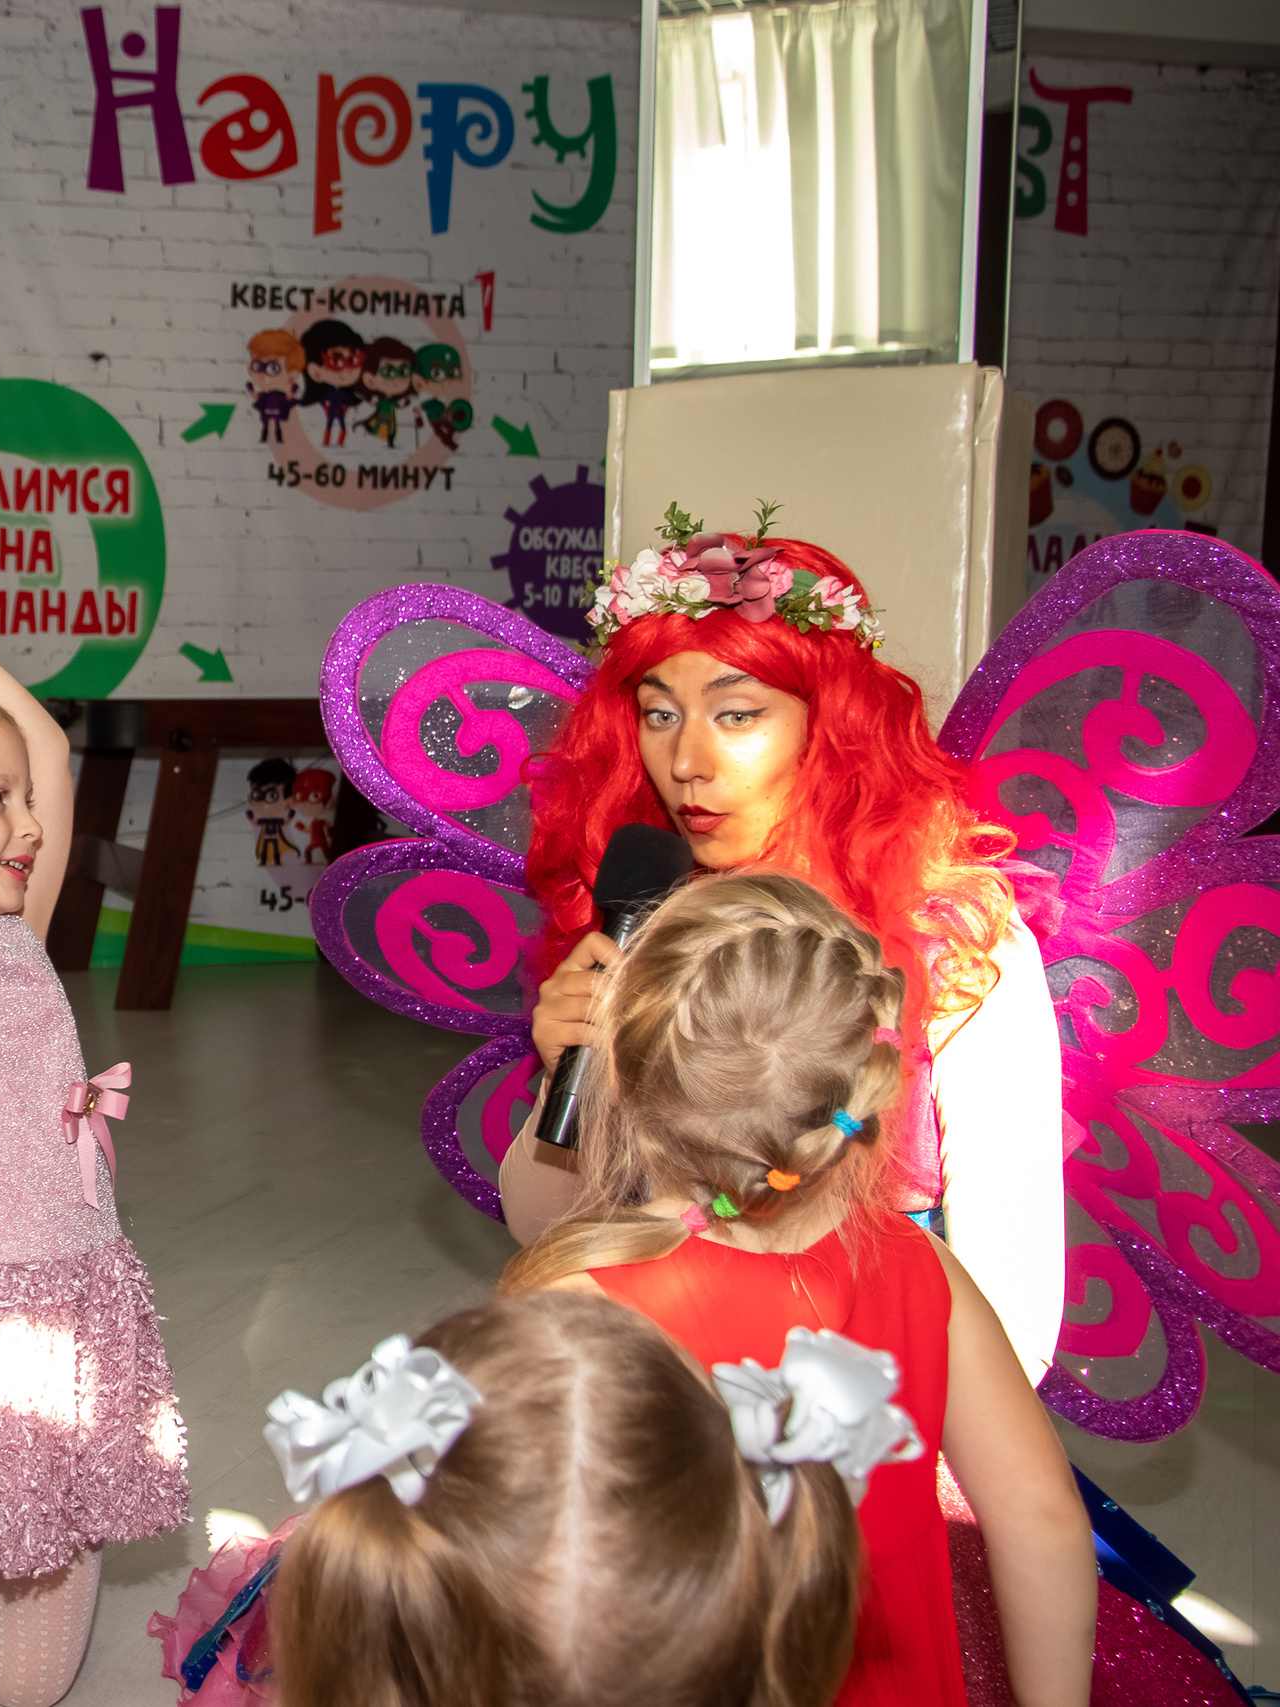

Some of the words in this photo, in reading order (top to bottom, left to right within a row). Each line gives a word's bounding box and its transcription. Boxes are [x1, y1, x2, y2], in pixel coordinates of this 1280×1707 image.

[80, 5, 618, 236] Happy
[231, 283, 465, 317] КВЕСТ-КОМНАТА
[268, 461, 347, 489] 45-60
[357, 464, 455, 493] МИНУТ
[523, 582, 563, 608] 5-10
[260, 886, 312, 911] 45-
